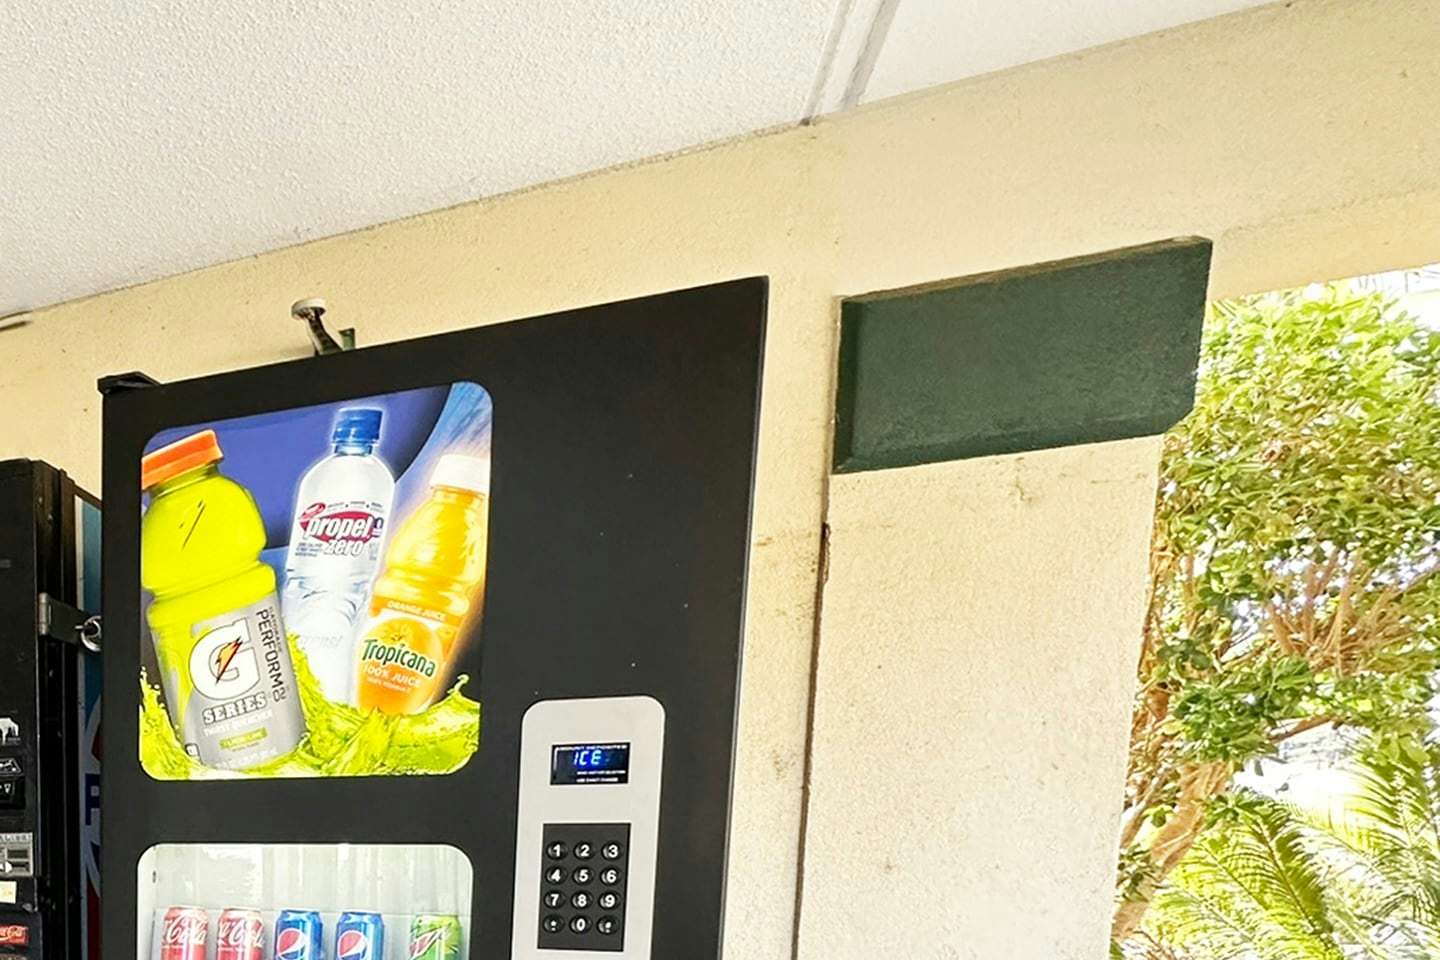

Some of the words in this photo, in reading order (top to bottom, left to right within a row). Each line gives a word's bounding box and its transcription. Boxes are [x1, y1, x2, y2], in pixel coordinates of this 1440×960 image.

[323, 540, 364, 556] zero
[255, 608, 284, 690] PERFORM
[188, 616, 262, 701] G
[362, 638, 437, 678] Tropicana
[202, 690, 268, 725] SERIES
[573, 749, 602, 766] ICE
[553, 843, 561, 857] 1
[580, 843, 590, 857] 2
[608, 844, 618, 858] 3
[550, 868, 561, 882] 4
[578, 868, 589, 882] 5
[606, 869, 617, 883] 6
[550, 893, 560, 907] 7
[577, 893, 587, 907] 8
[604, 894, 616, 908] 9
[576, 918, 586, 932] 0
